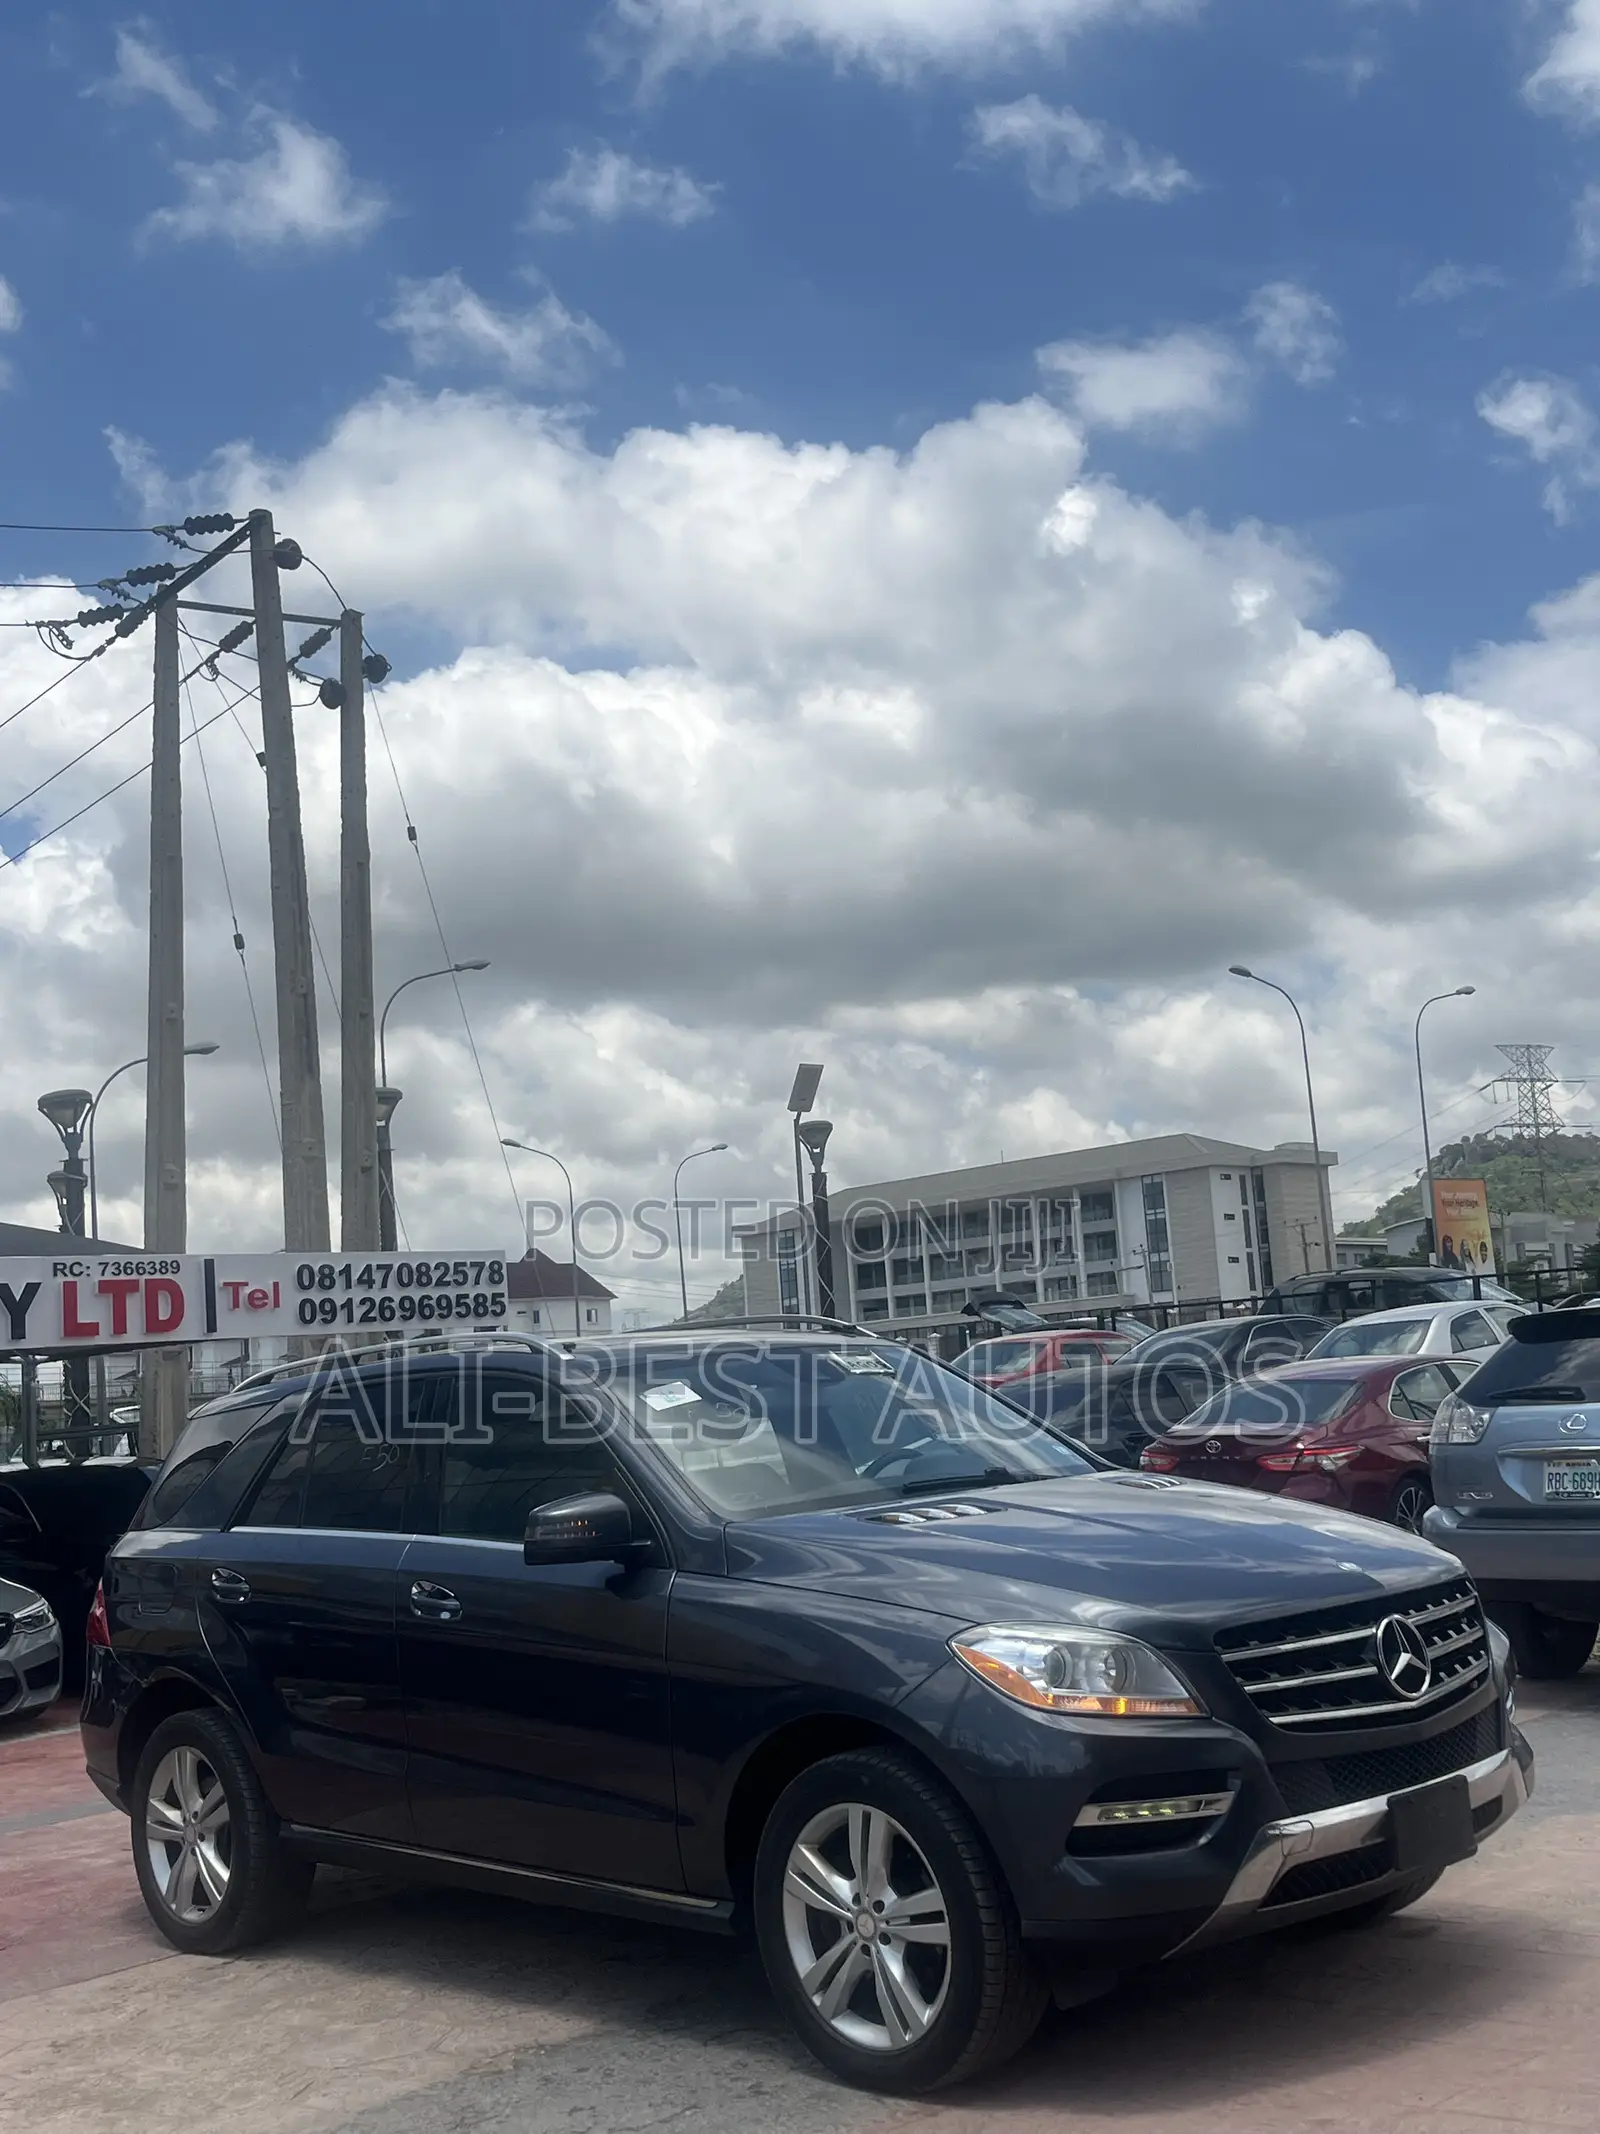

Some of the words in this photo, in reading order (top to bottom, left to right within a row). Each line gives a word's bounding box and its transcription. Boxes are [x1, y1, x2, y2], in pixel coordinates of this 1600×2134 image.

[53, 1262, 91, 1277] RC:
[98, 1260, 181, 1276] 7366389
[296, 1260, 505, 1291] 08147082578
[62, 1278, 185, 1338] LTD
[222, 1281, 280, 1310] Tel
[298, 1292, 506, 1324] 09126969585
